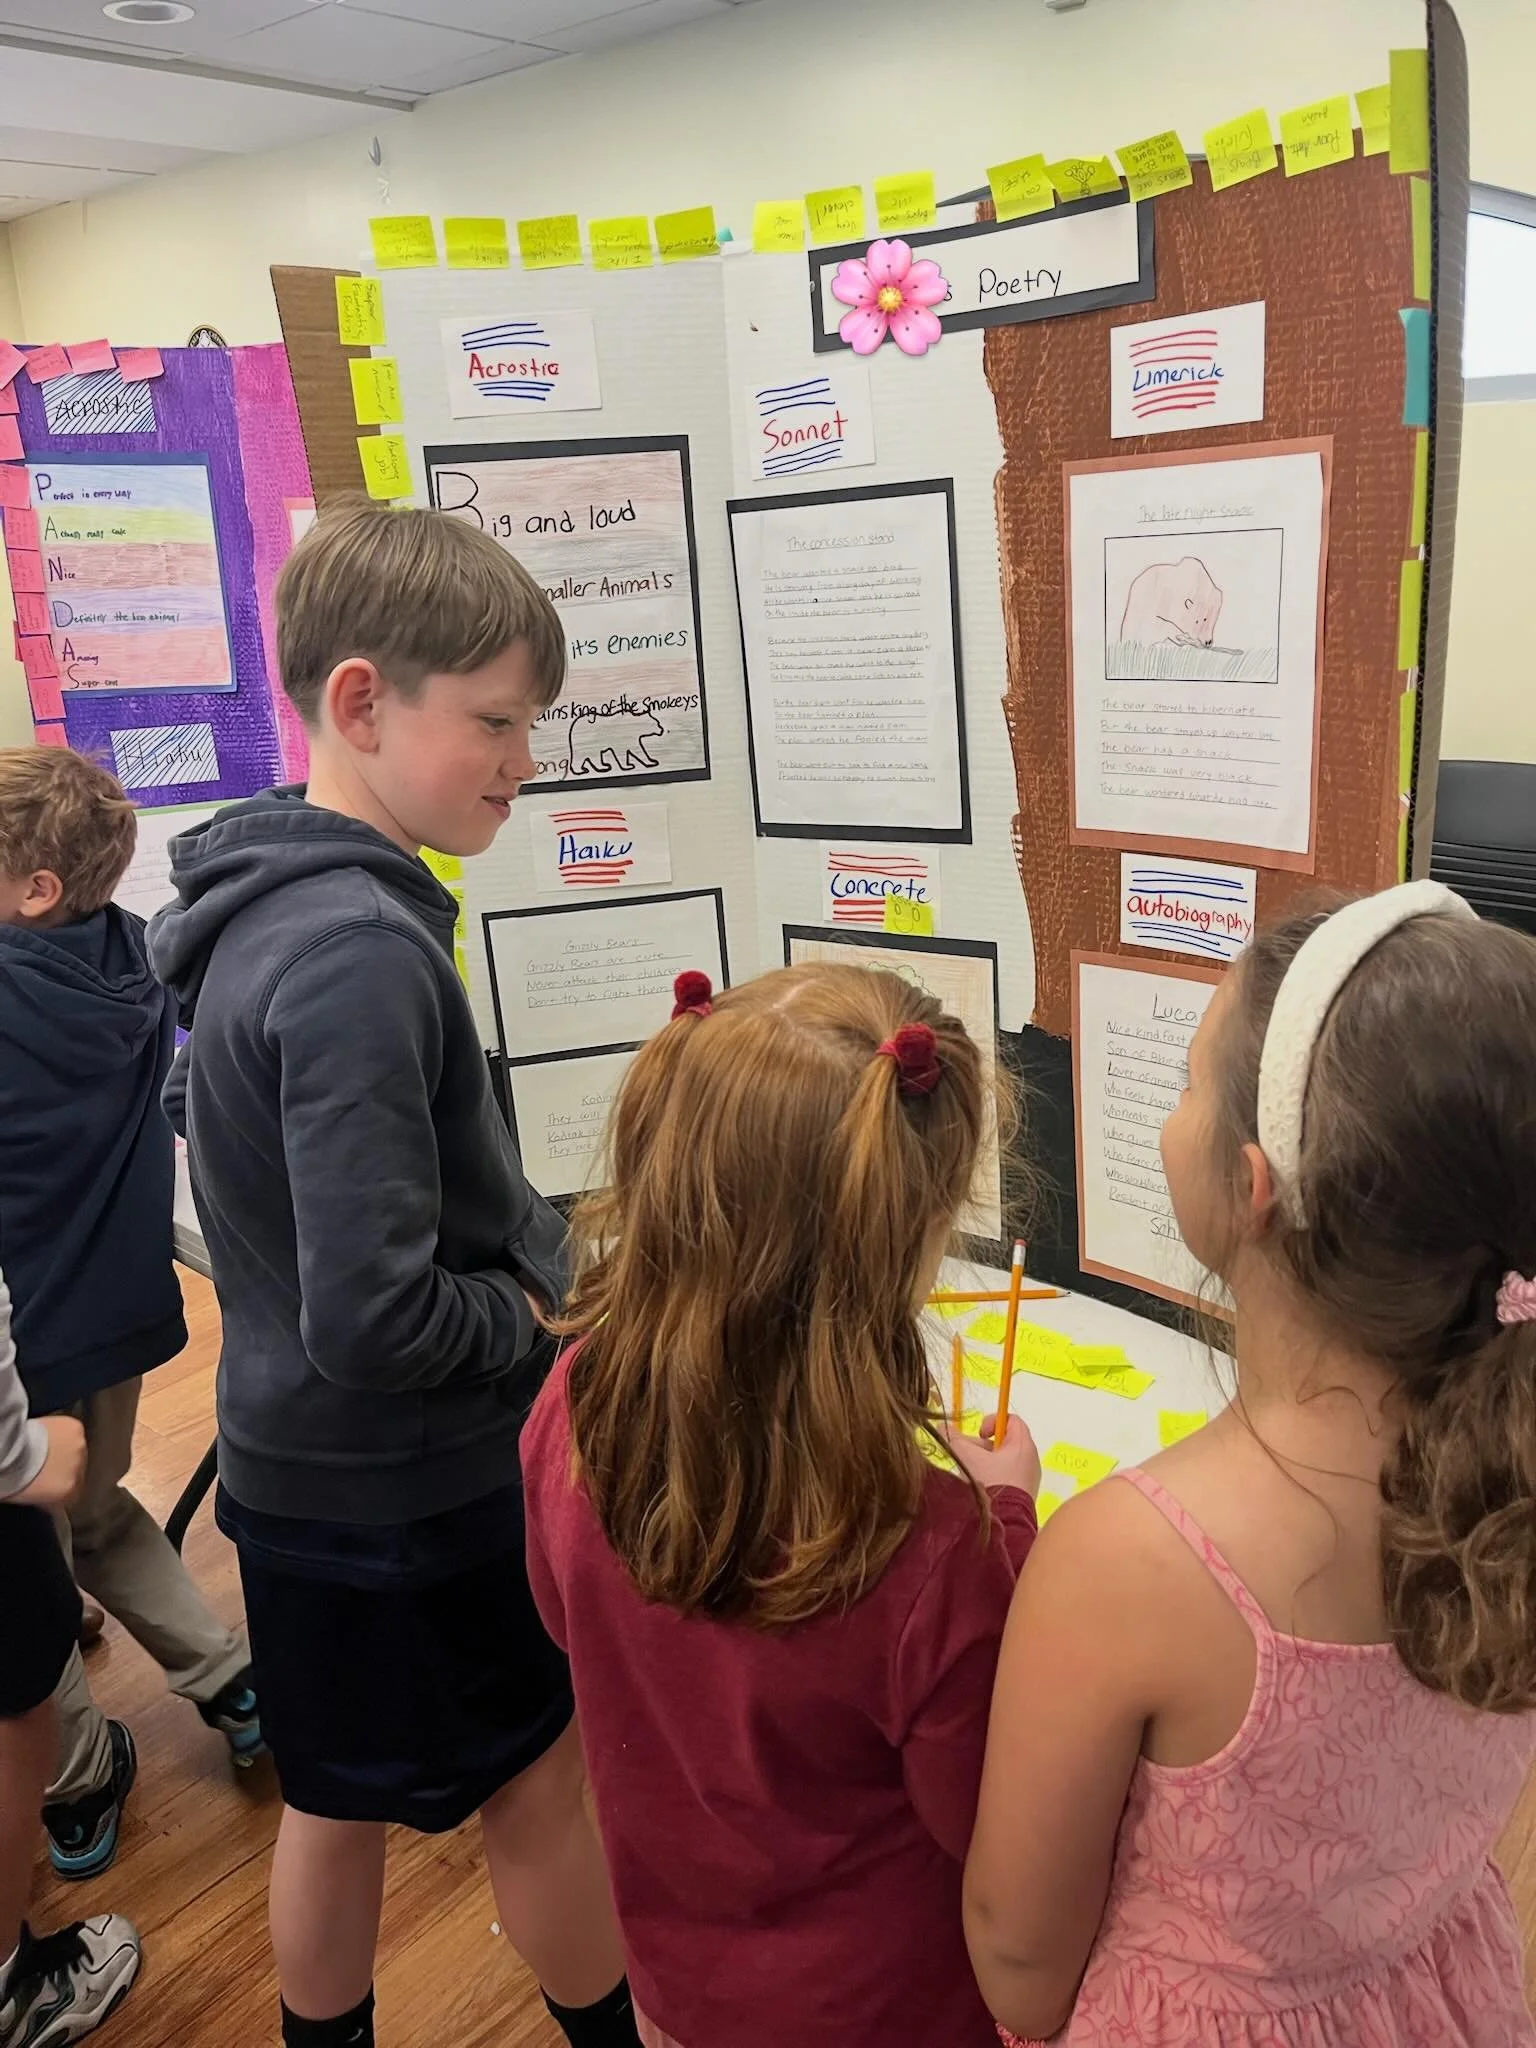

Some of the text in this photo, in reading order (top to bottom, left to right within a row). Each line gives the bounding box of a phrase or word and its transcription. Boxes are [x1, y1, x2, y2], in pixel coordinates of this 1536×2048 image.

[979, 268, 1062, 303] Poetry
[469, 353, 560, 379] Acrostic
[1133, 362, 1225, 392] Limerick
[55, 394, 141, 421] Acrostic
[763, 410, 848, 453] Sonnet
[526, 509, 575, 534] and
[590, 499, 636, 530] loud
[47, 556, 77, 582] Nice
[600, 571, 673, 598] Animals
[114, 611, 128, 622] the
[571, 630, 688, 659] it's enemies
[66, 663, 99, 690] Super
[571, 701, 598, 724] king
[601, 699, 616, 715] of
[617, 694, 638, 715] the
[559, 834, 633, 865] Haiku
[830, 873, 931, 903] Concrete
[1127, 893, 1252, 941] autobiography
[1107, 1060, 1133, 1077] Lover
